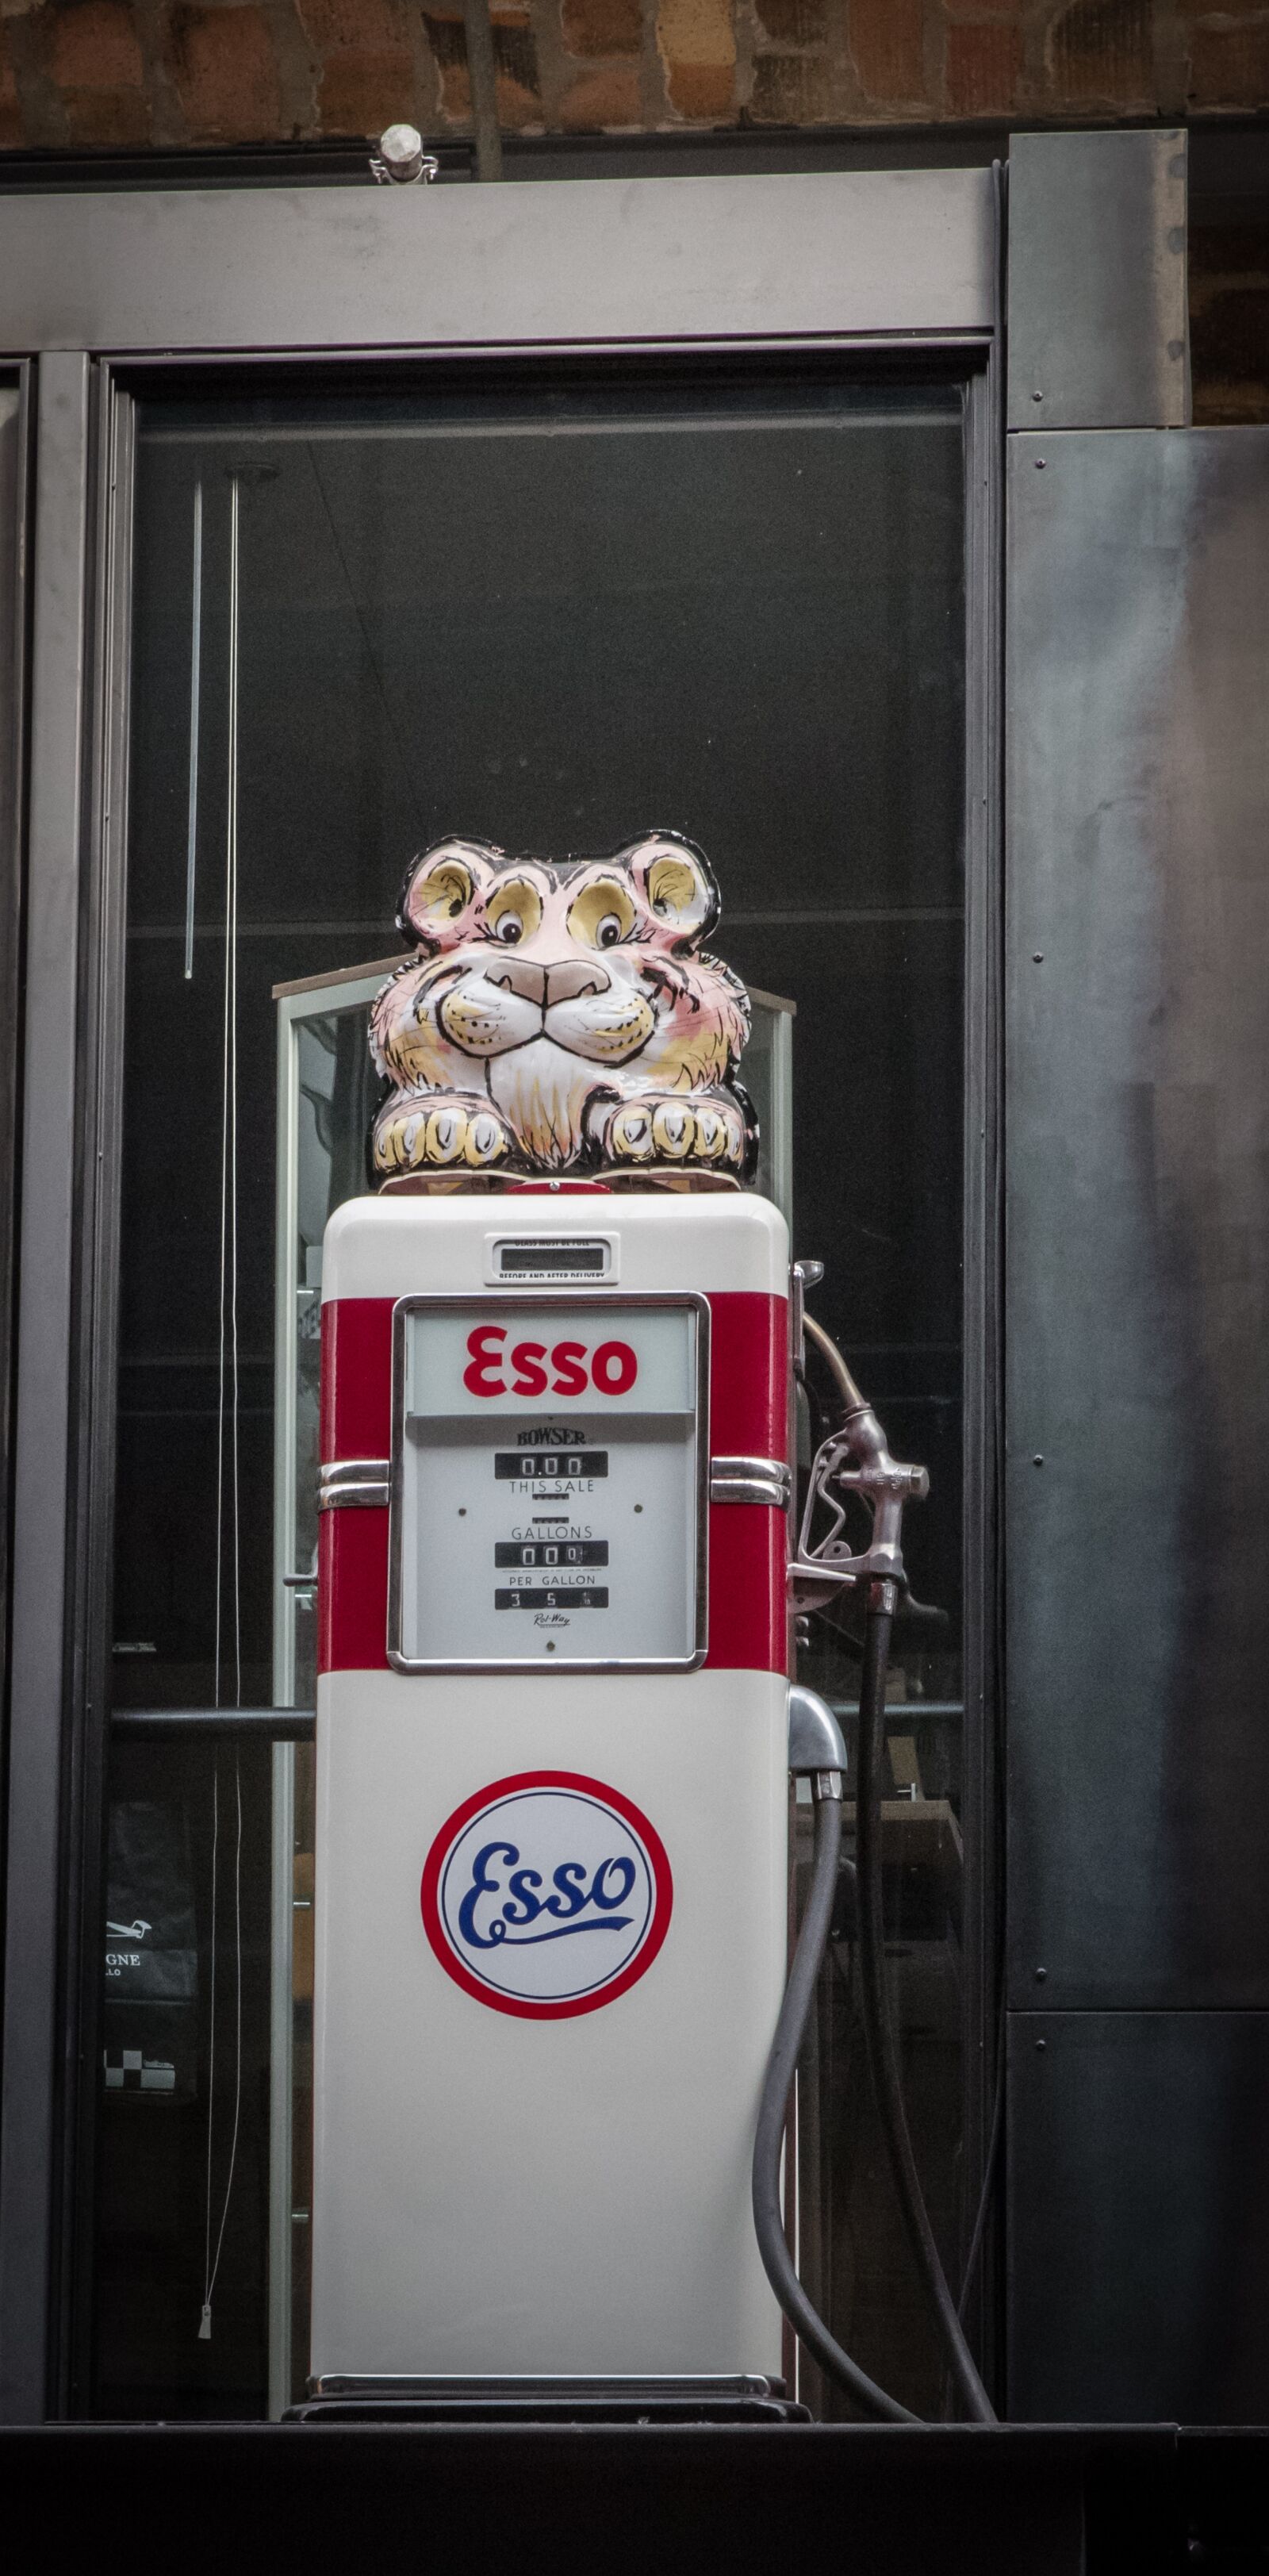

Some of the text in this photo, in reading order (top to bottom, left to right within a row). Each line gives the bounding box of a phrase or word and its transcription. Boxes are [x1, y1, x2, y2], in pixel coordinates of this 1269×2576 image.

[517, 1428, 587, 1445] BOWSER
[509, 1480, 594, 1493] THIS SALE
[512, 1526, 592, 1540] GALLONS
[509, 1576, 595, 1586] PER GALLON
[458, 1841, 635, 1948] Esso
